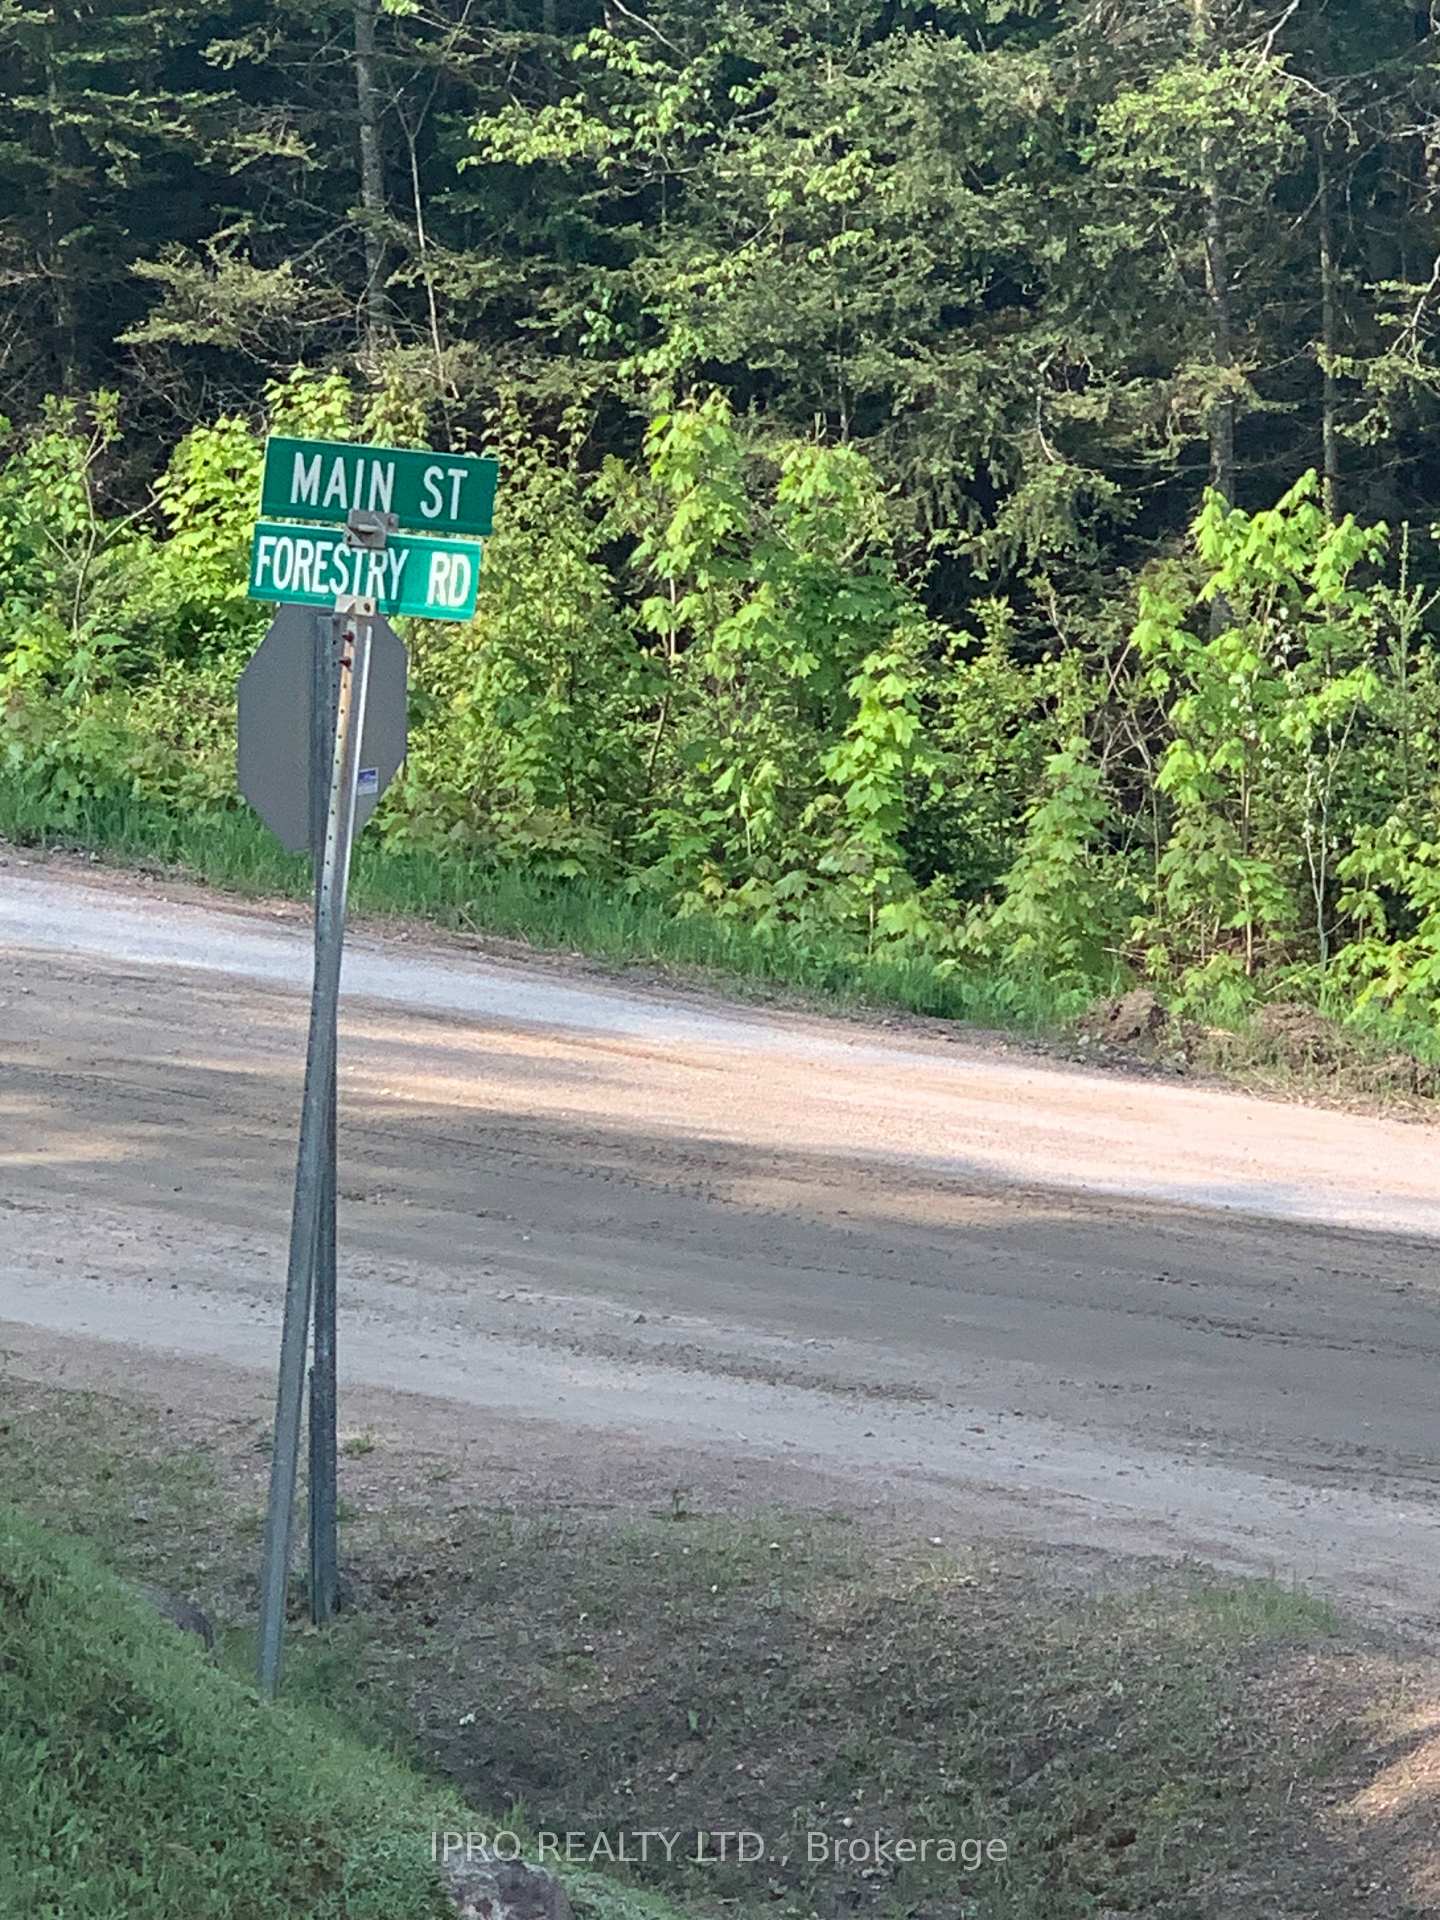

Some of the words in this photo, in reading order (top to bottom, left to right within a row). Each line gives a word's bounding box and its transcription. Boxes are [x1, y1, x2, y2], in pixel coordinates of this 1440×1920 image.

[290, 452, 395, 513] MAIN
[420, 466, 468, 520] ST
[254, 536, 410, 600] FORESTRY
[426, 551, 472, 607] RD
